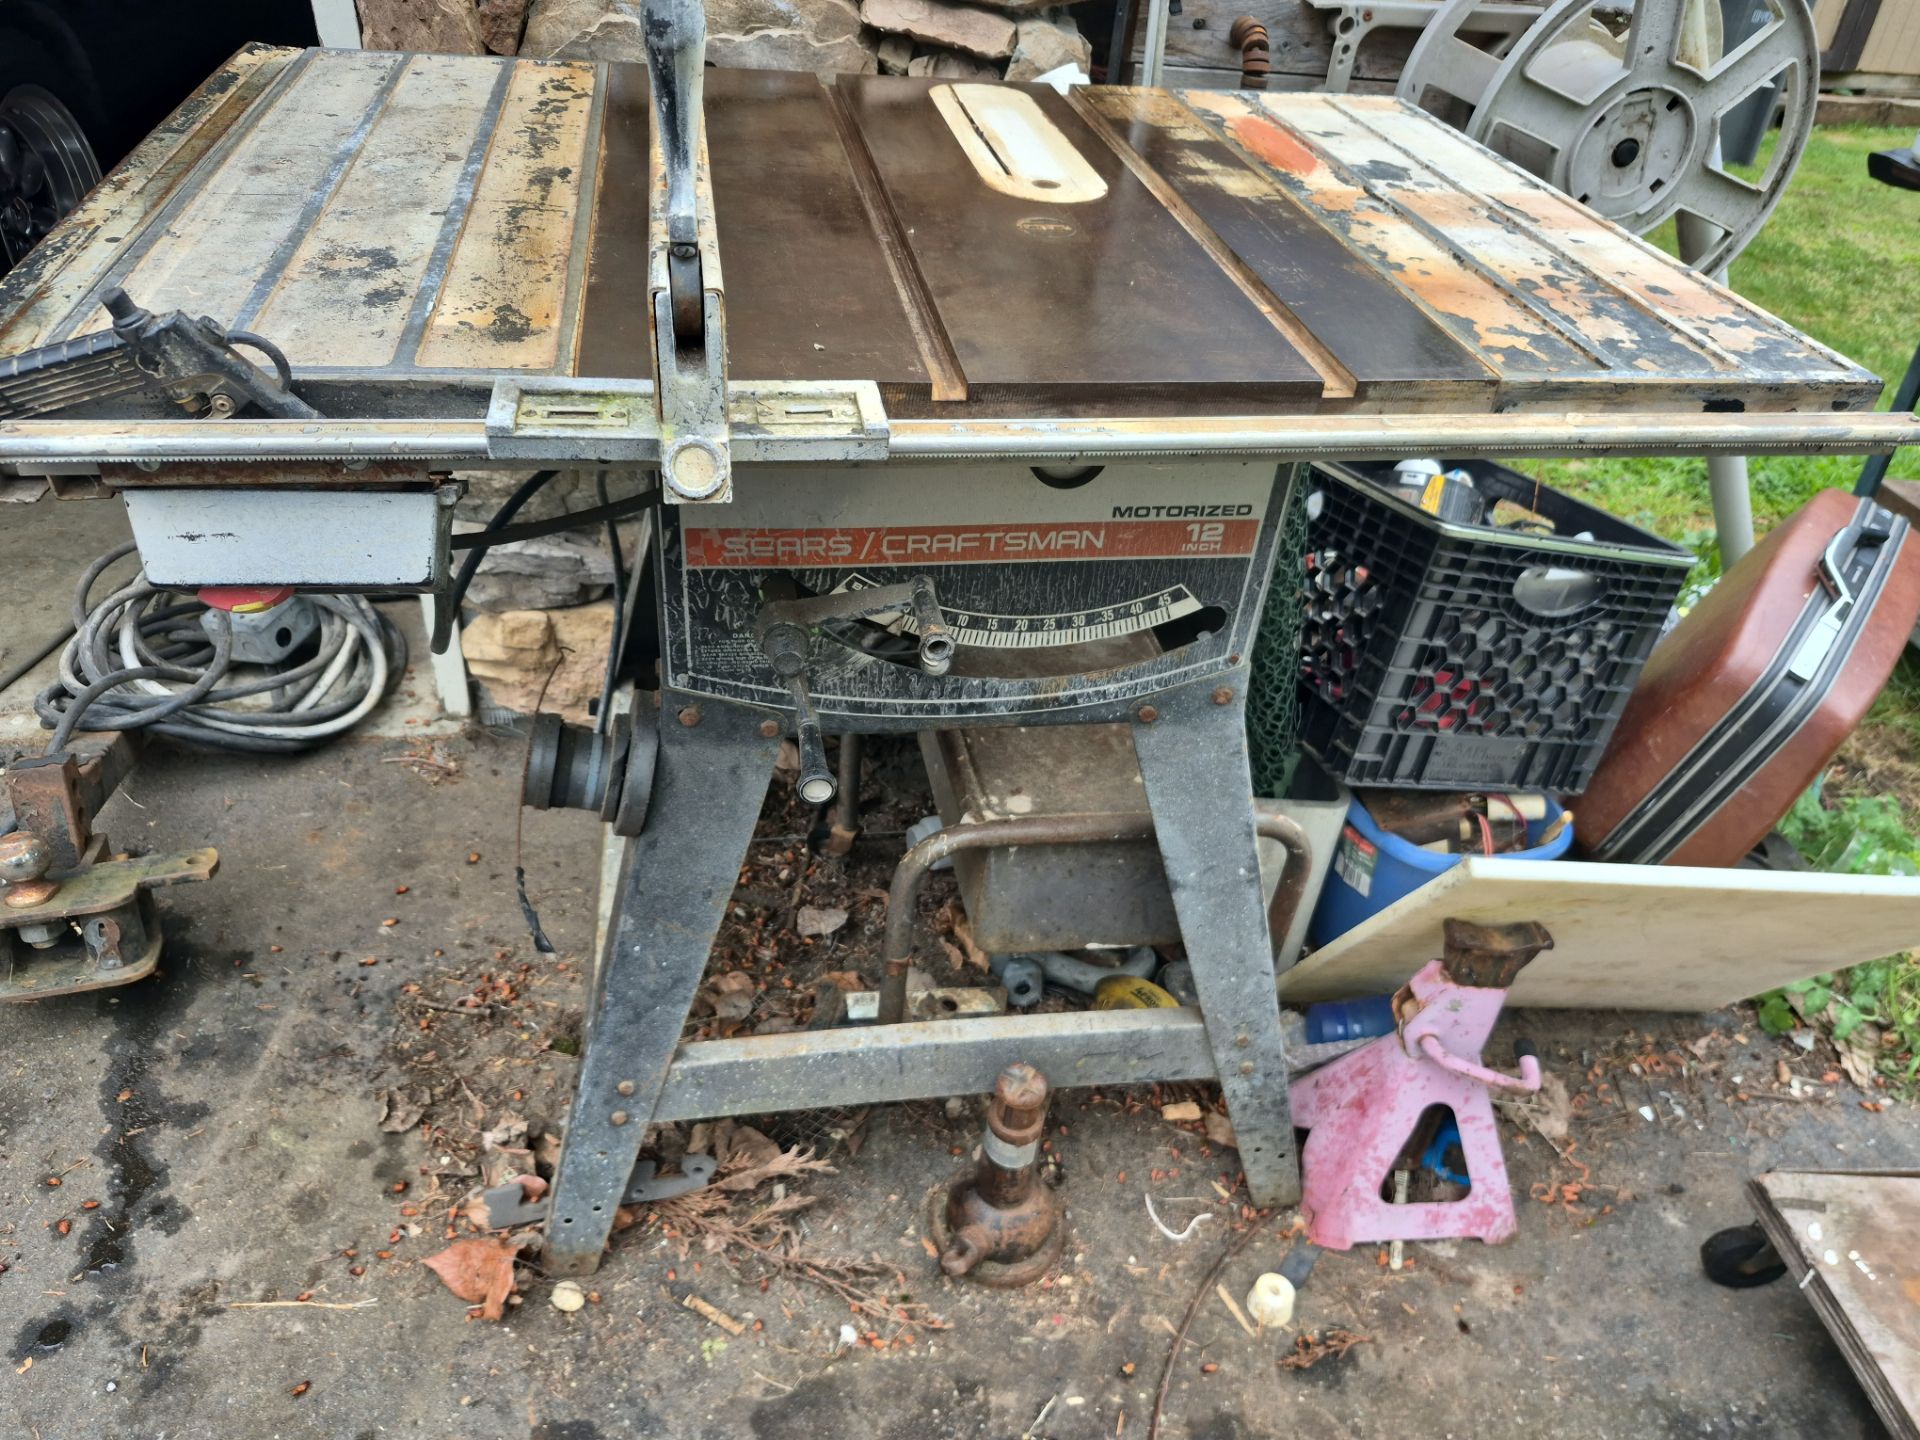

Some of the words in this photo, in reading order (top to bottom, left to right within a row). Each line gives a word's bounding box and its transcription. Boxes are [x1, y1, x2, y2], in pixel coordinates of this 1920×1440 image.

[1112, 504, 1253, 518] MOTORIZED
[1185, 523, 1224, 541] 12
[1181, 542, 1221, 552] INCH
[956, 614, 970, 627] 10
[986, 618, 999, 631] 15
[1014, 619, 1028, 632] 20
[1043, 618, 1056, 631] 25
[1072, 615, 1086, 627] 30
[1101, 610, 1115, 622] 35
[1129, 603, 1143, 615] 40
[1158, 594, 1171, 606] 45
